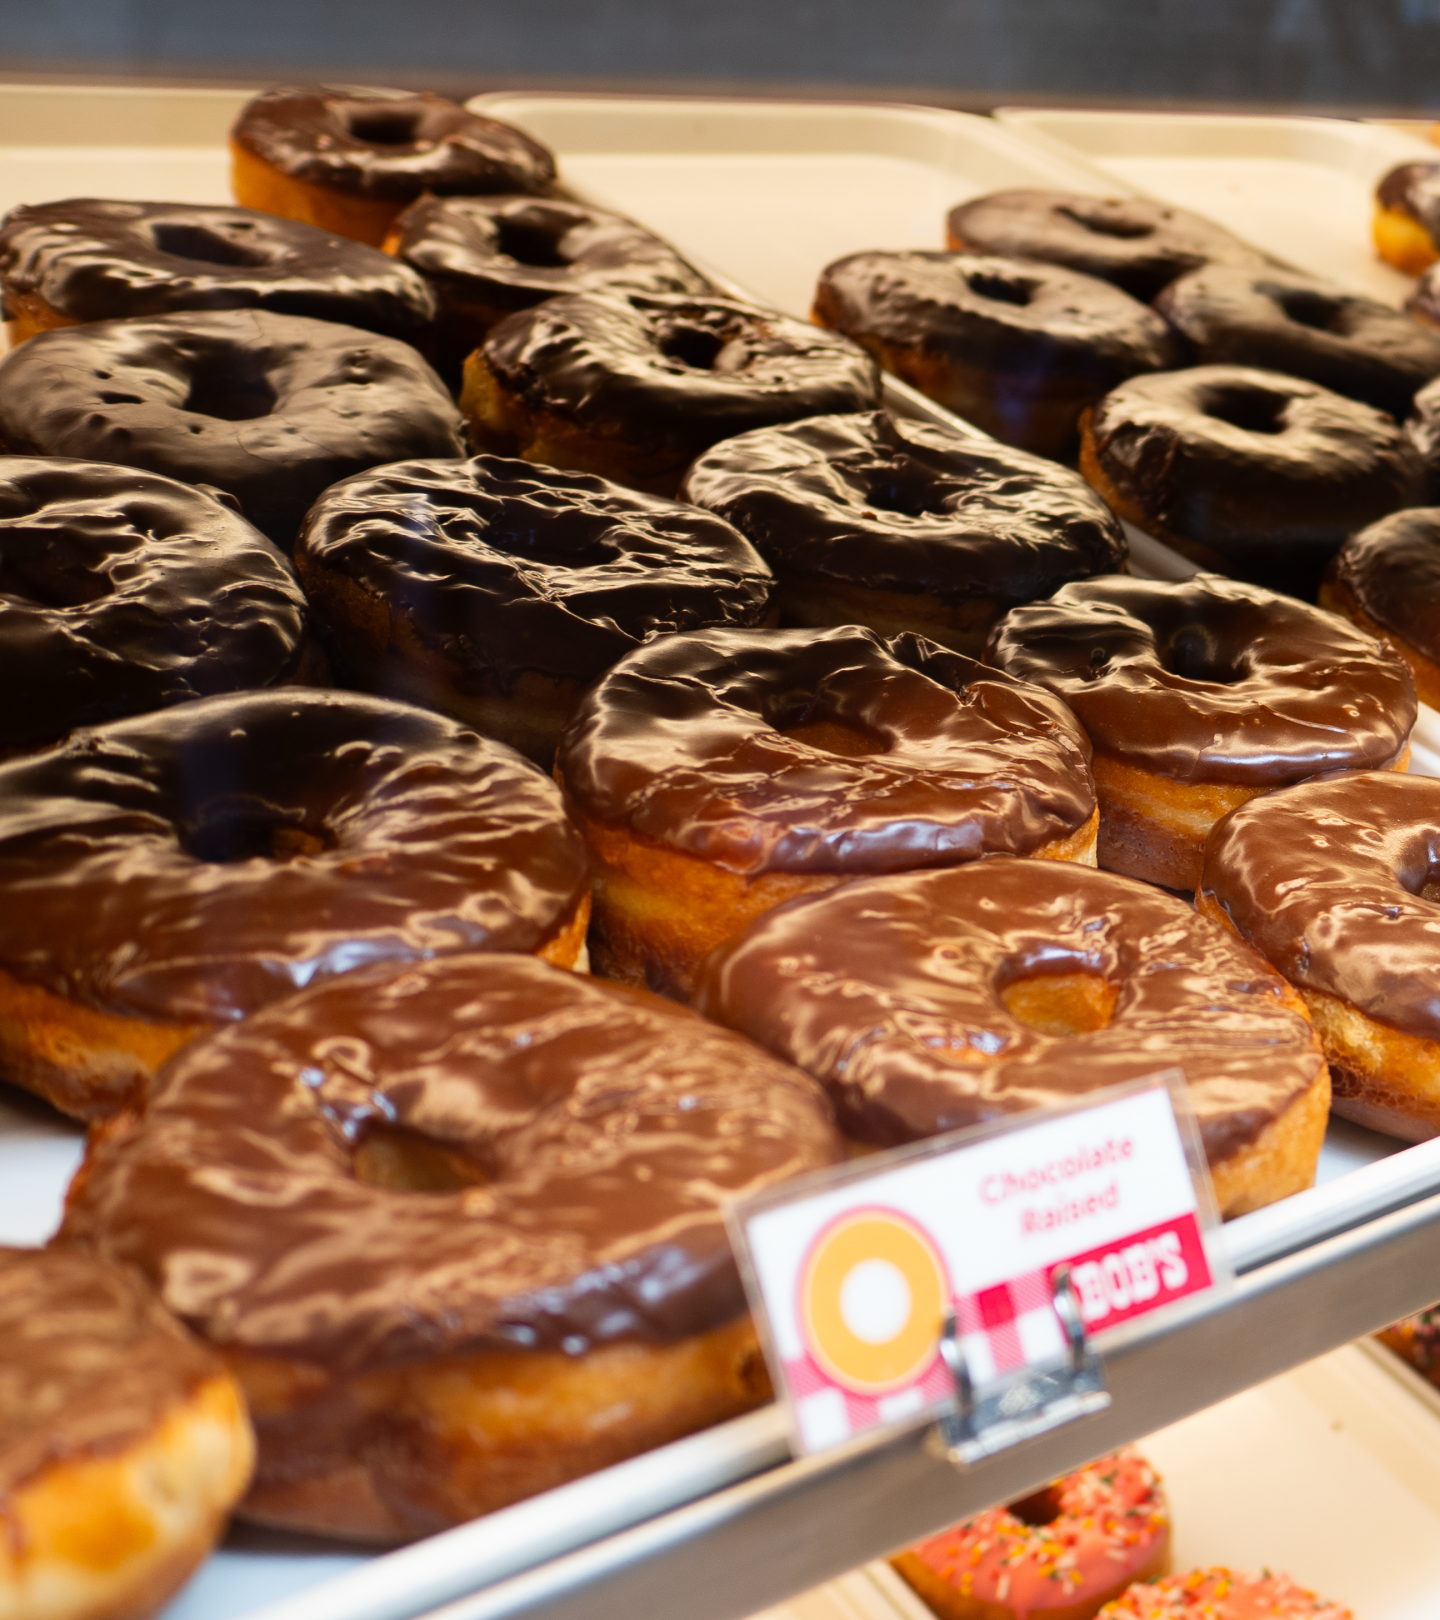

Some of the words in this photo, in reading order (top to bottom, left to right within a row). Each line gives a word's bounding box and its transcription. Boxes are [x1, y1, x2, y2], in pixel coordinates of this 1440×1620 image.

[980, 1137, 1133, 1206] Chocolate
[1022, 1177, 1119, 1238] Raised
[1070, 1230, 1189, 1322] BOB'S
